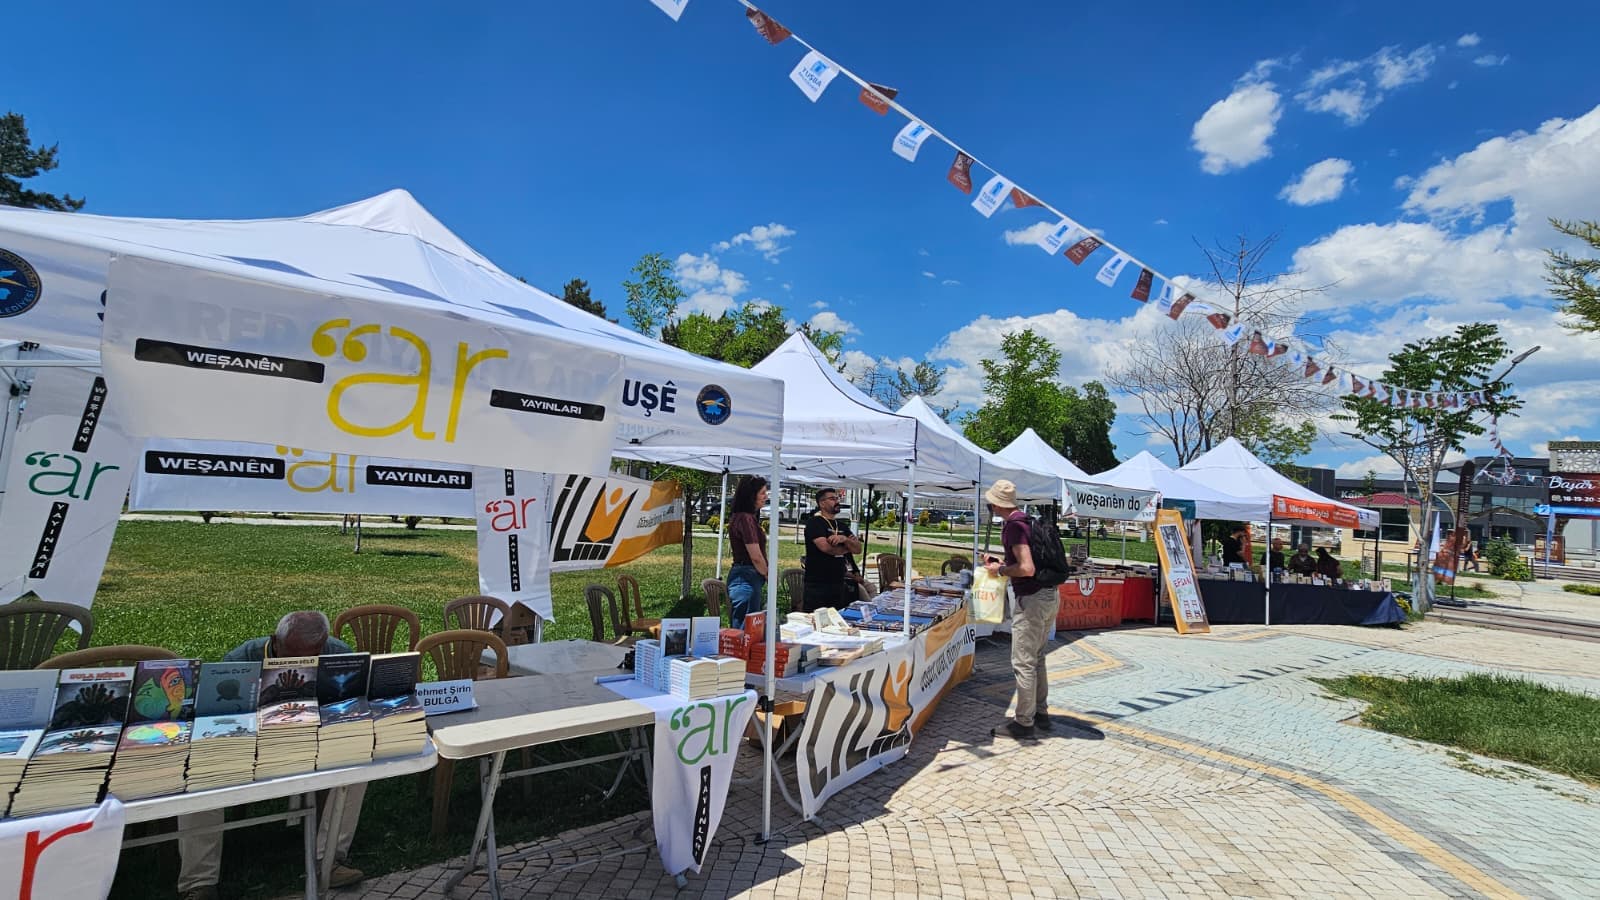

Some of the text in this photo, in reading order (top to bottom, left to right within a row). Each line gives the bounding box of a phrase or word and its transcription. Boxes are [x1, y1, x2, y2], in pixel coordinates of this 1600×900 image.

[186, 350, 284, 373] WEŞANÊN
[520, 398, 582, 415] YAYINLARI
[158, 456, 275, 474] WEŞANÊN
[375, 470, 466, 486] YAYINLARI
[35, 503, 66, 577] YAYINLARI
[424, 695, 459, 706] BULGA
